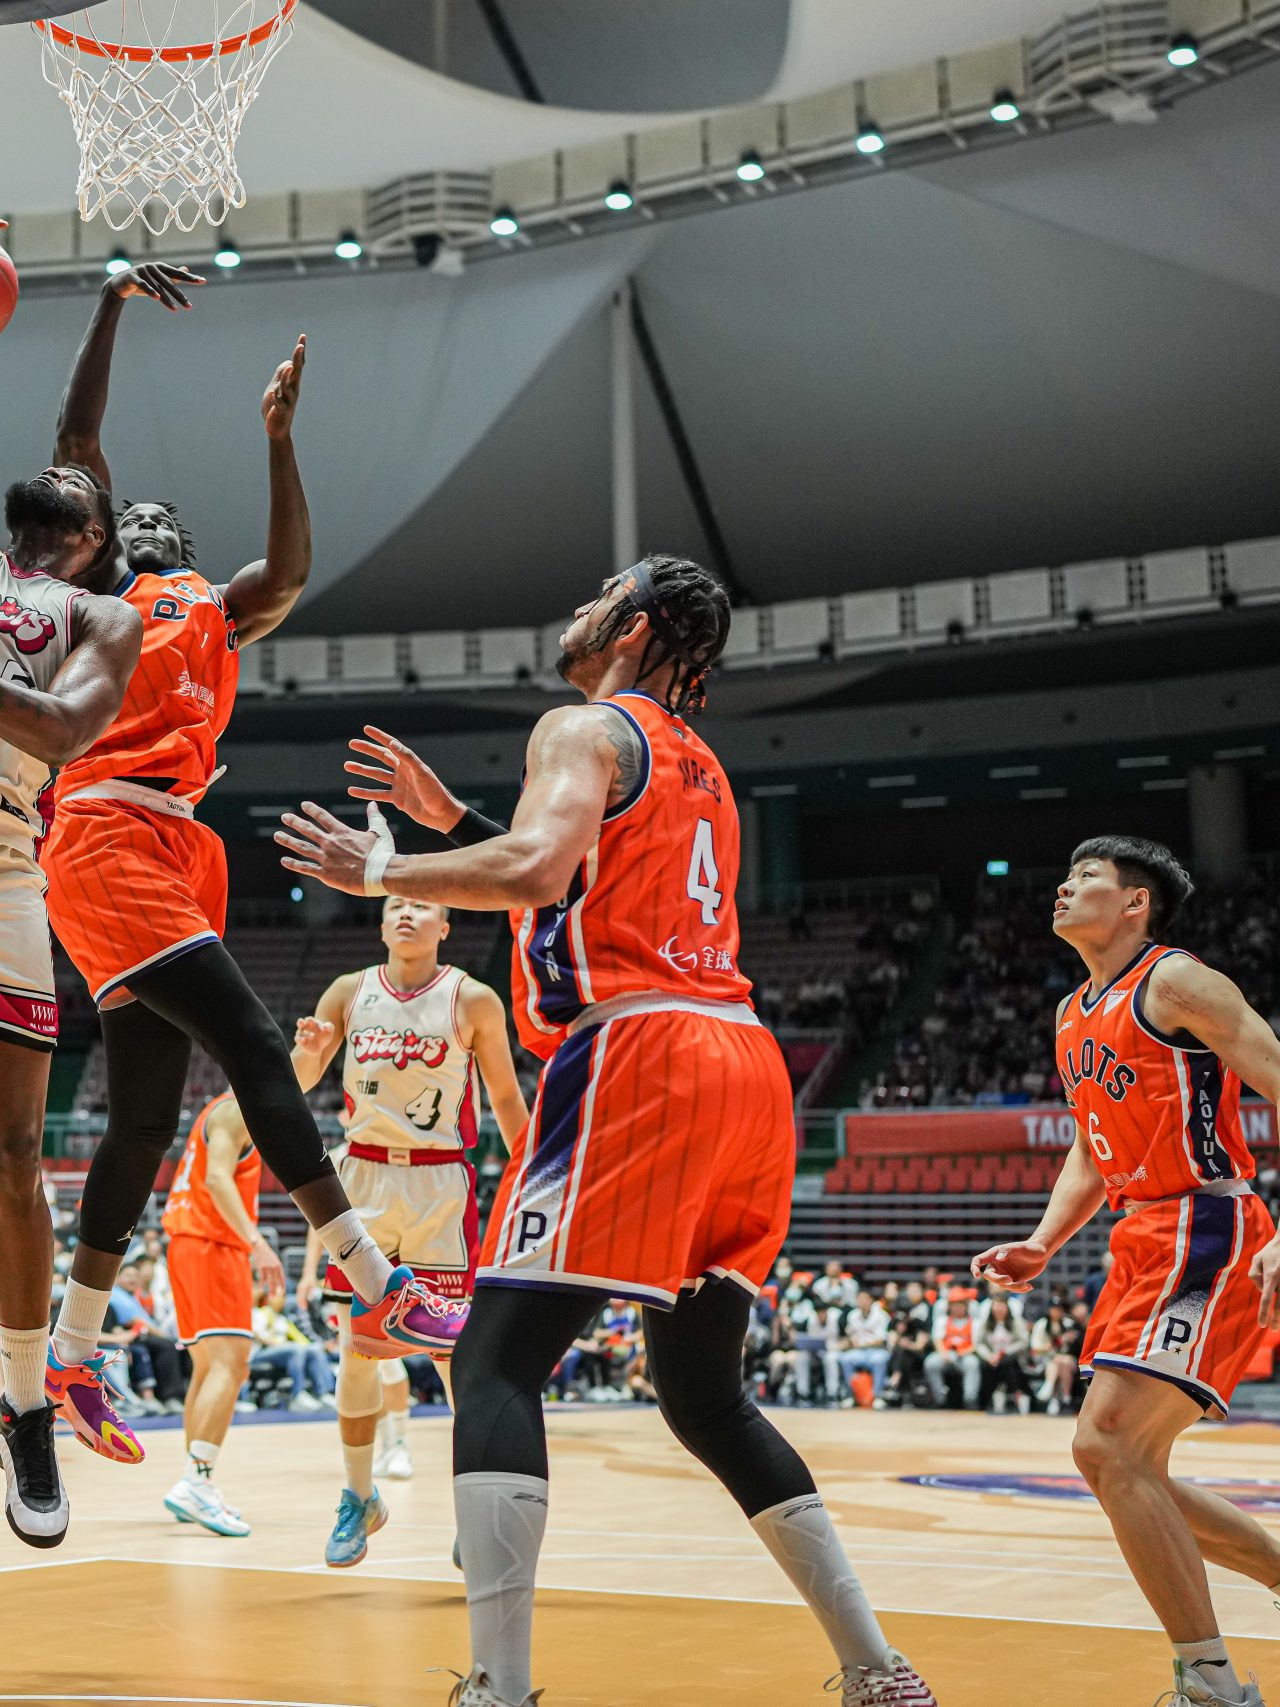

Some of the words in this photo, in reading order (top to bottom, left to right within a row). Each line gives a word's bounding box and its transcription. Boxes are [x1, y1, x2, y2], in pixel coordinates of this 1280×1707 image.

[686, 816, 722, 925] 4
[702, 946, 734, 970] 全球
[405, 1087, 443, 1131] 4
[1088, 1111, 1114, 1161] 6
[517, 1210, 548, 1253] P
[1161, 1316, 1192, 1351] P
